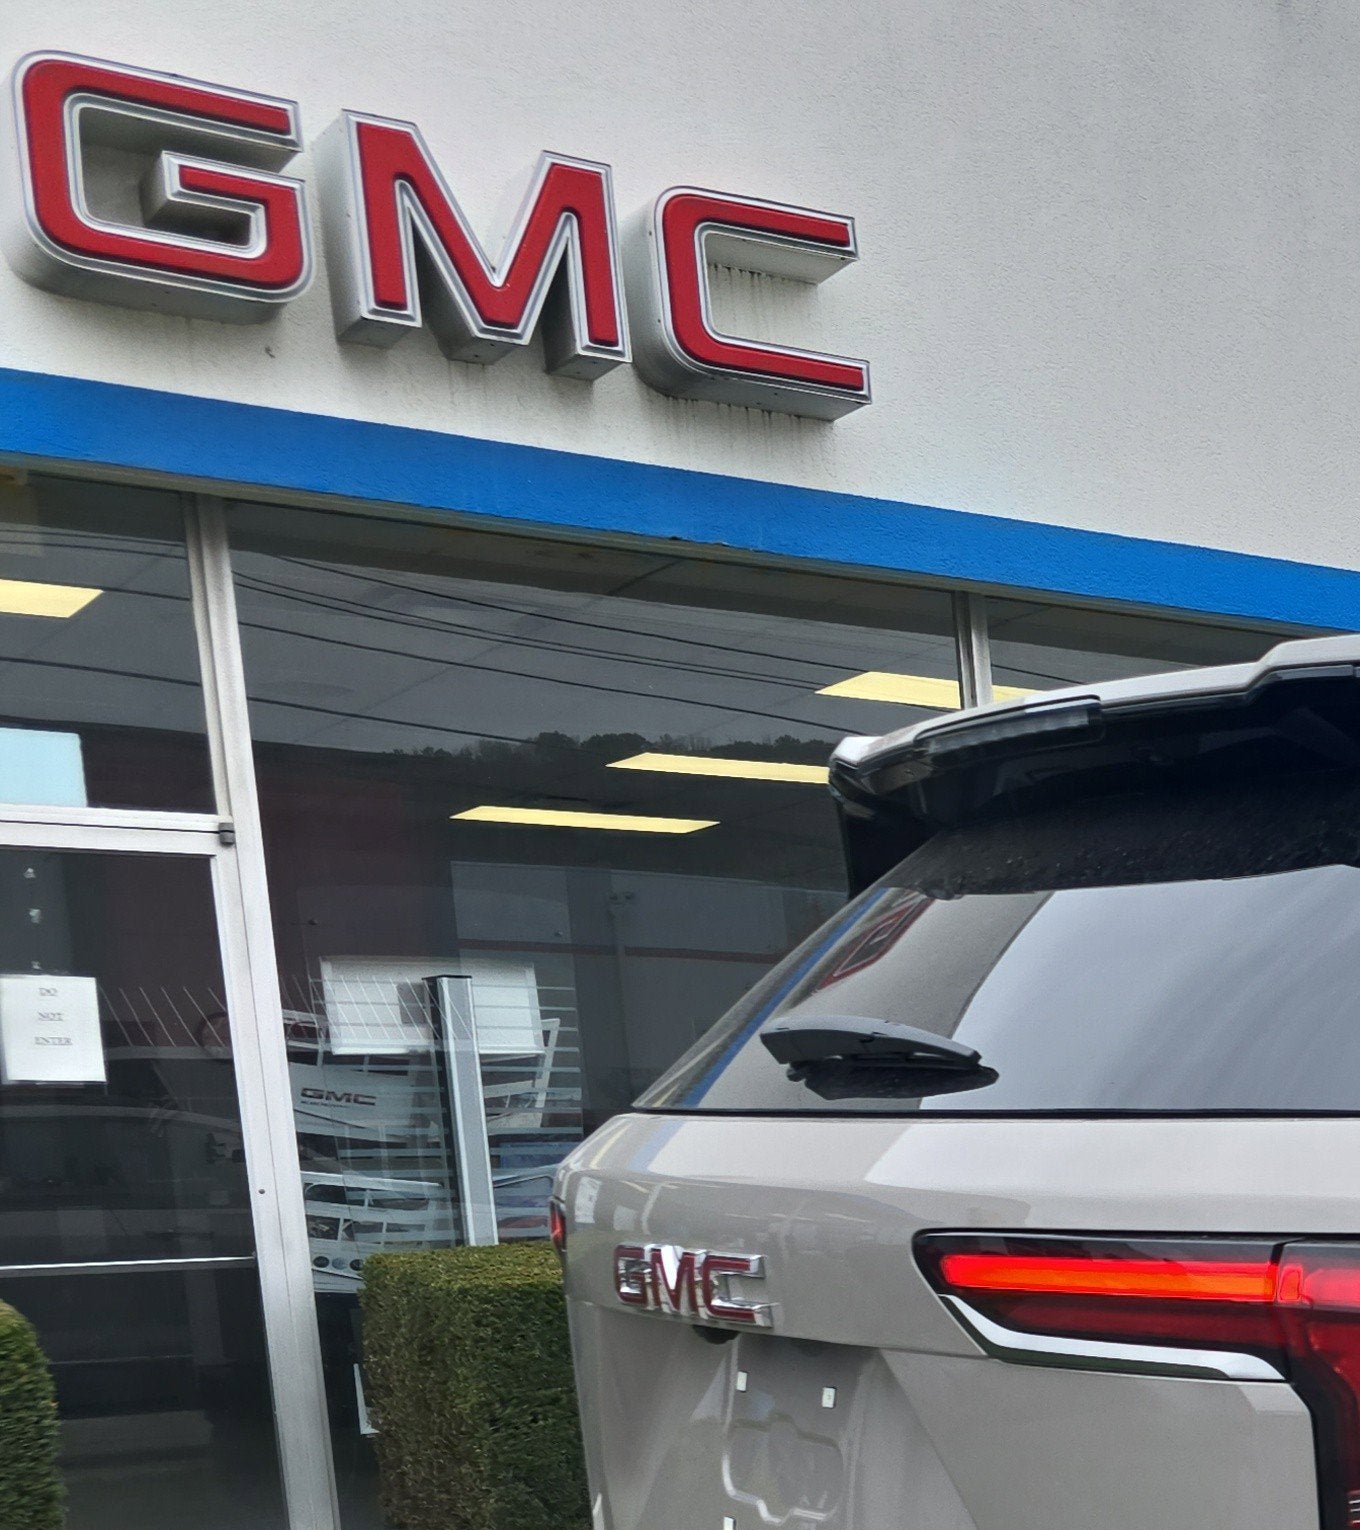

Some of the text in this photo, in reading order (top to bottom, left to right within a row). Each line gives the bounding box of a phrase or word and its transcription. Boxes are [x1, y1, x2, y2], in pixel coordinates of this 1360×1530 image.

[11, 50, 872, 412] GMC
[39, 987, 57, 997] DO
[38, 1011, 63, 1021] NOT
[34, 1036, 73, 1046] ENTER
[301, 1087, 376, 1106] GMC
[613, 1242, 775, 1329] GMC
